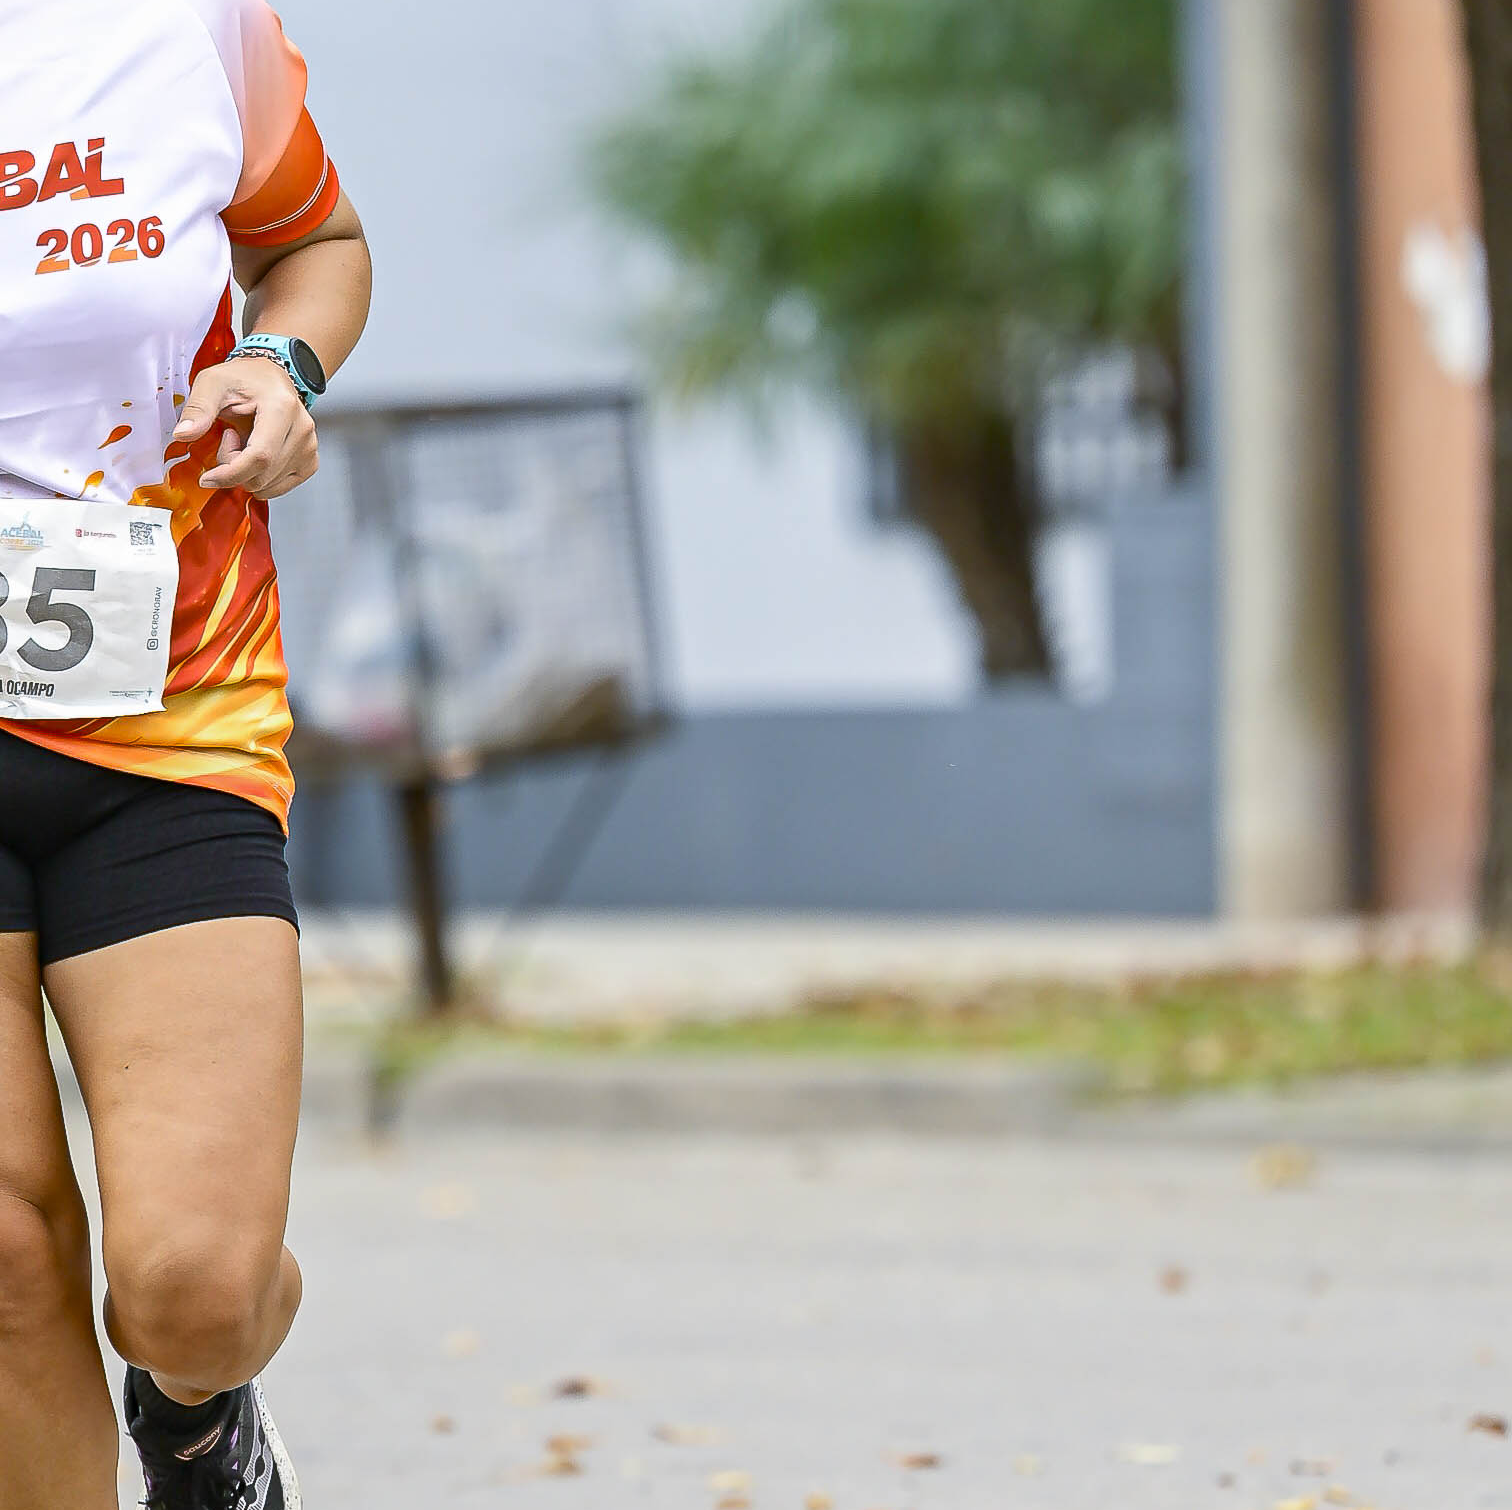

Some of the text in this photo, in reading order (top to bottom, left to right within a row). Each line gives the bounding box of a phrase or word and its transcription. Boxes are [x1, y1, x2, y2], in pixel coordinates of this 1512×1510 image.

[35, 215, 165, 275] 2026
[6, 679, 55, 698] OCAMPO
[183, 1426, 221, 1456] saucony
